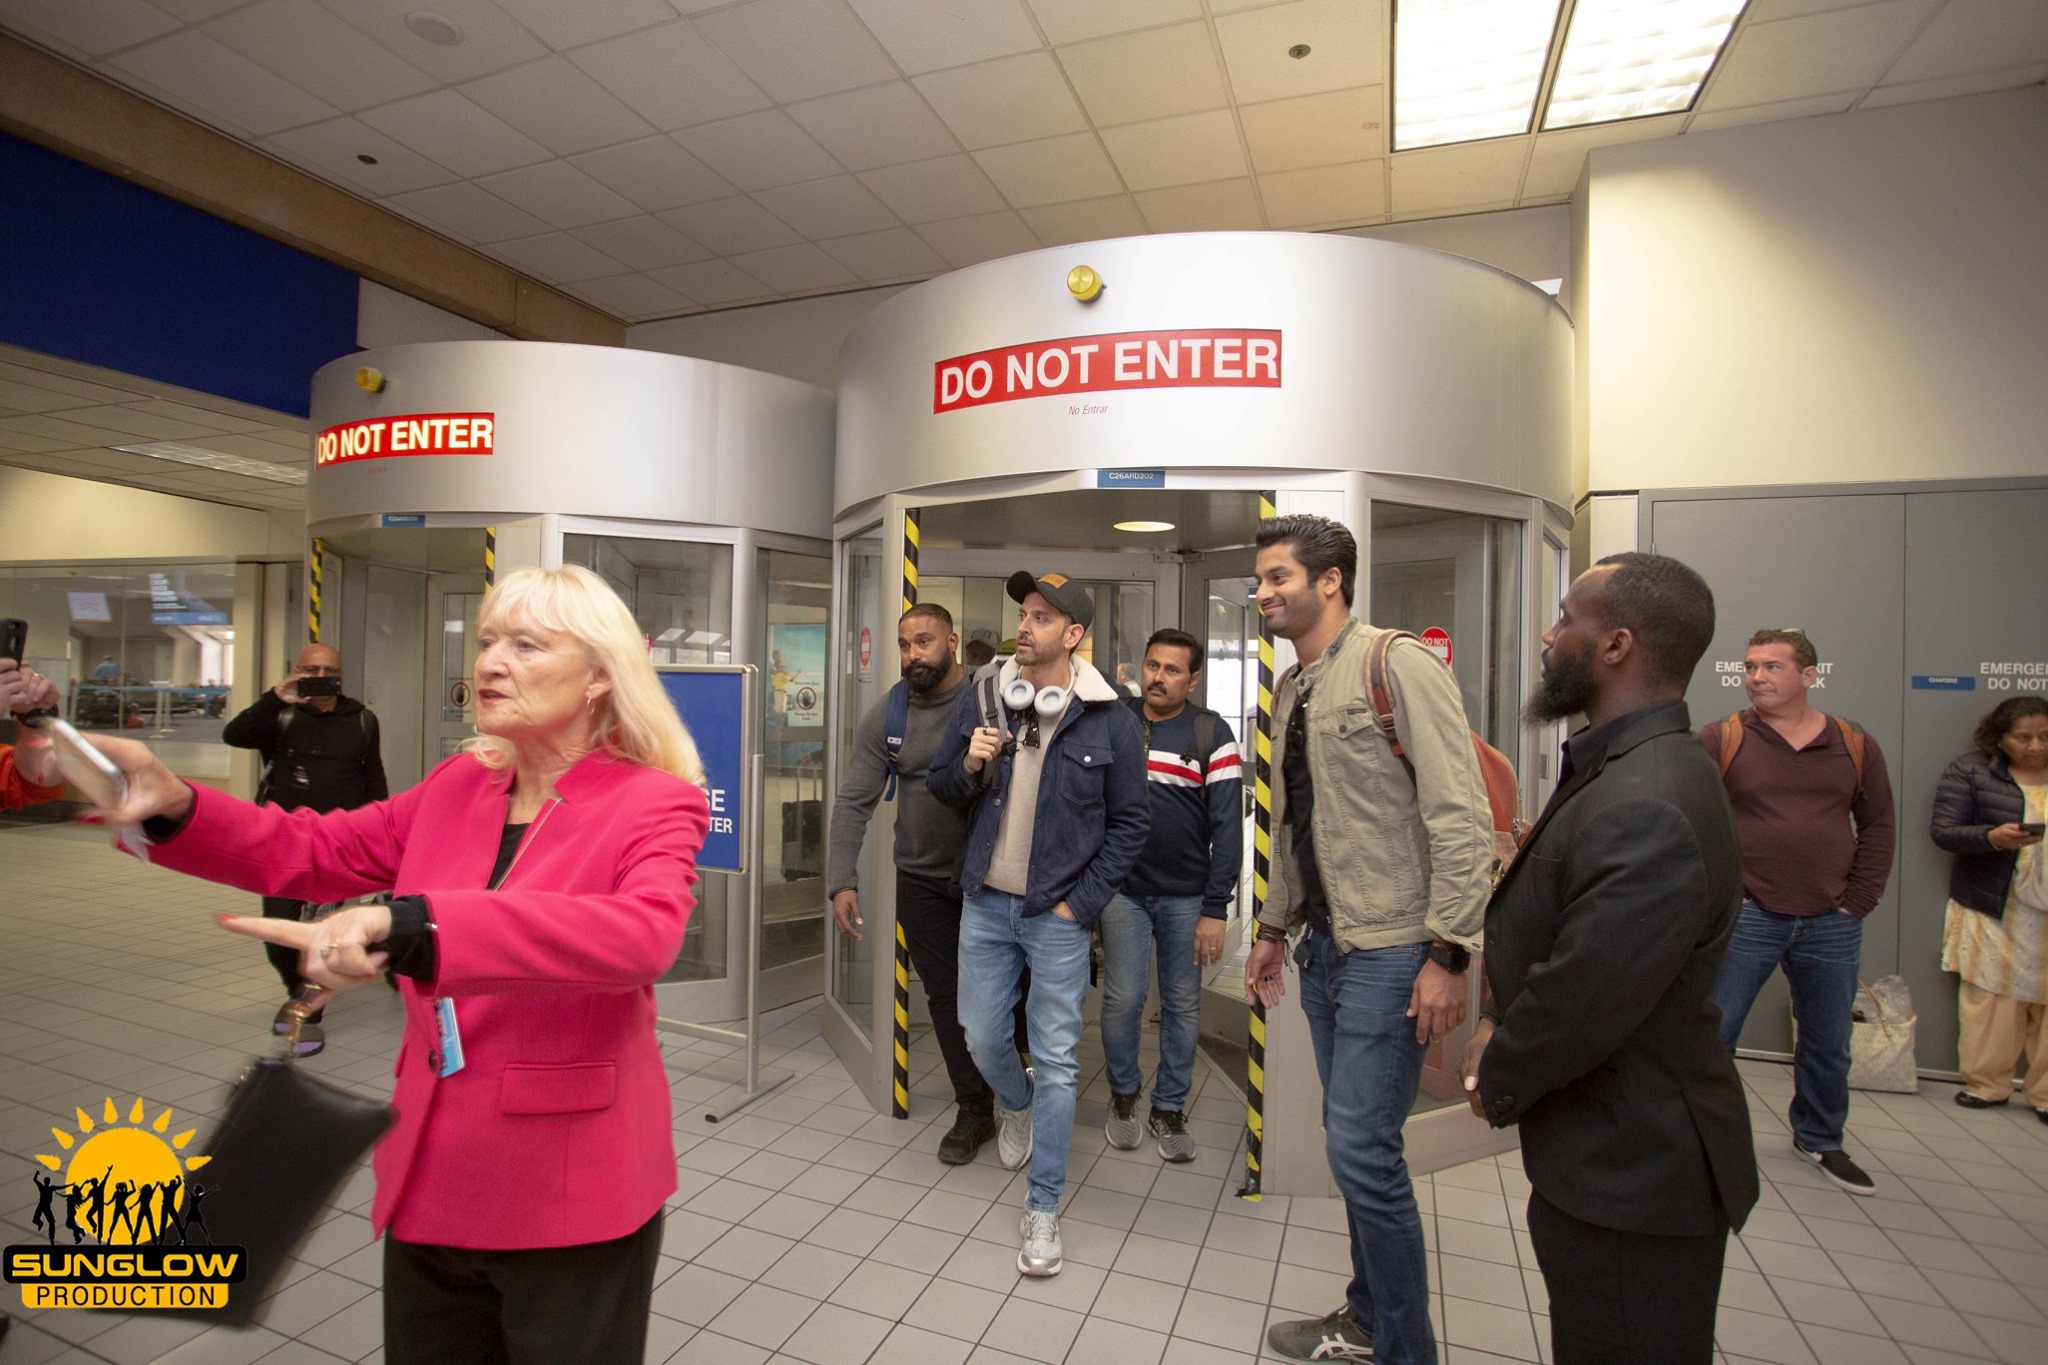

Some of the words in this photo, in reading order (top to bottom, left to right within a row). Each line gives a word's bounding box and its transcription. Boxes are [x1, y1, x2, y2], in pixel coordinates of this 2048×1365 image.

[941, 360, 993, 405] DO
[1006, 344, 1099, 393] NOT
[1114, 338, 1279, 382] ENTER
[1068, 406, 1080, 415] No
[1082, 405, 1109, 415] Entrar
[318, 432, 337, 464] DO
[340, 422, 386, 458] NOT
[391, 418, 493, 451] ENTER
[1421, 637, 1433, 646] DO
[1434, 637, 1449, 646] NOT
[1980, 662, 2048, 675] EMERGE
[1721, 675, 1742, 687] DO
[1987, 678, 2011, 690] DO
[2017, 678, 2048, 691] NOT
[708, 816, 733, 834] TER
